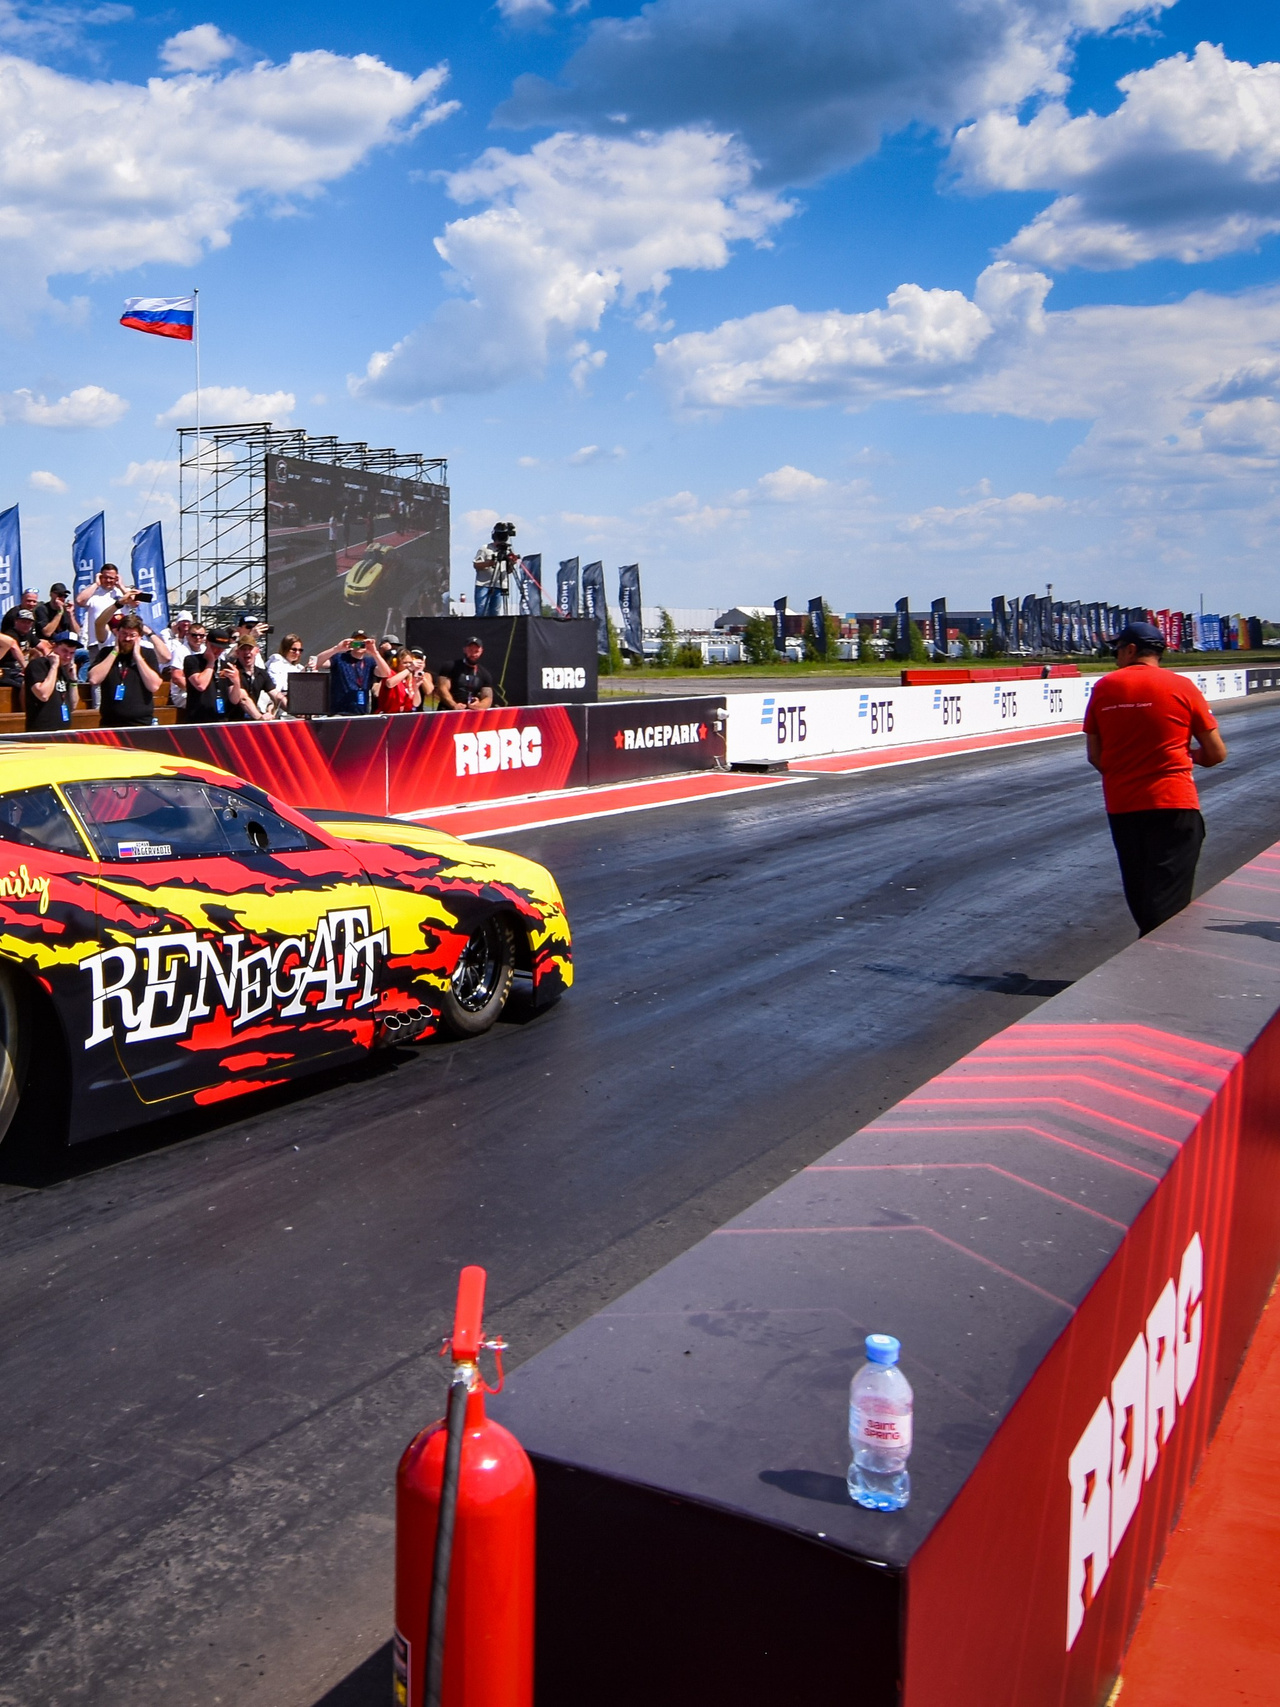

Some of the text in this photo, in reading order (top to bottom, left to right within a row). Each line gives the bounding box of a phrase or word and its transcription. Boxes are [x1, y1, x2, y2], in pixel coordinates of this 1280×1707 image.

[542, 667, 585, 689] RDRC
[871, 701, 894, 734] ВТБ
[943, 696, 961, 725] ВТБ
[1002, 691, 1017, 718] ВТБ
[624, 723, 700, 750] RACEPARK
[777, 706, 807, 744] ВТБ
[453, 726, 542, 777] RDRC
[1066, 1231, 1203, 1652] RDRC
